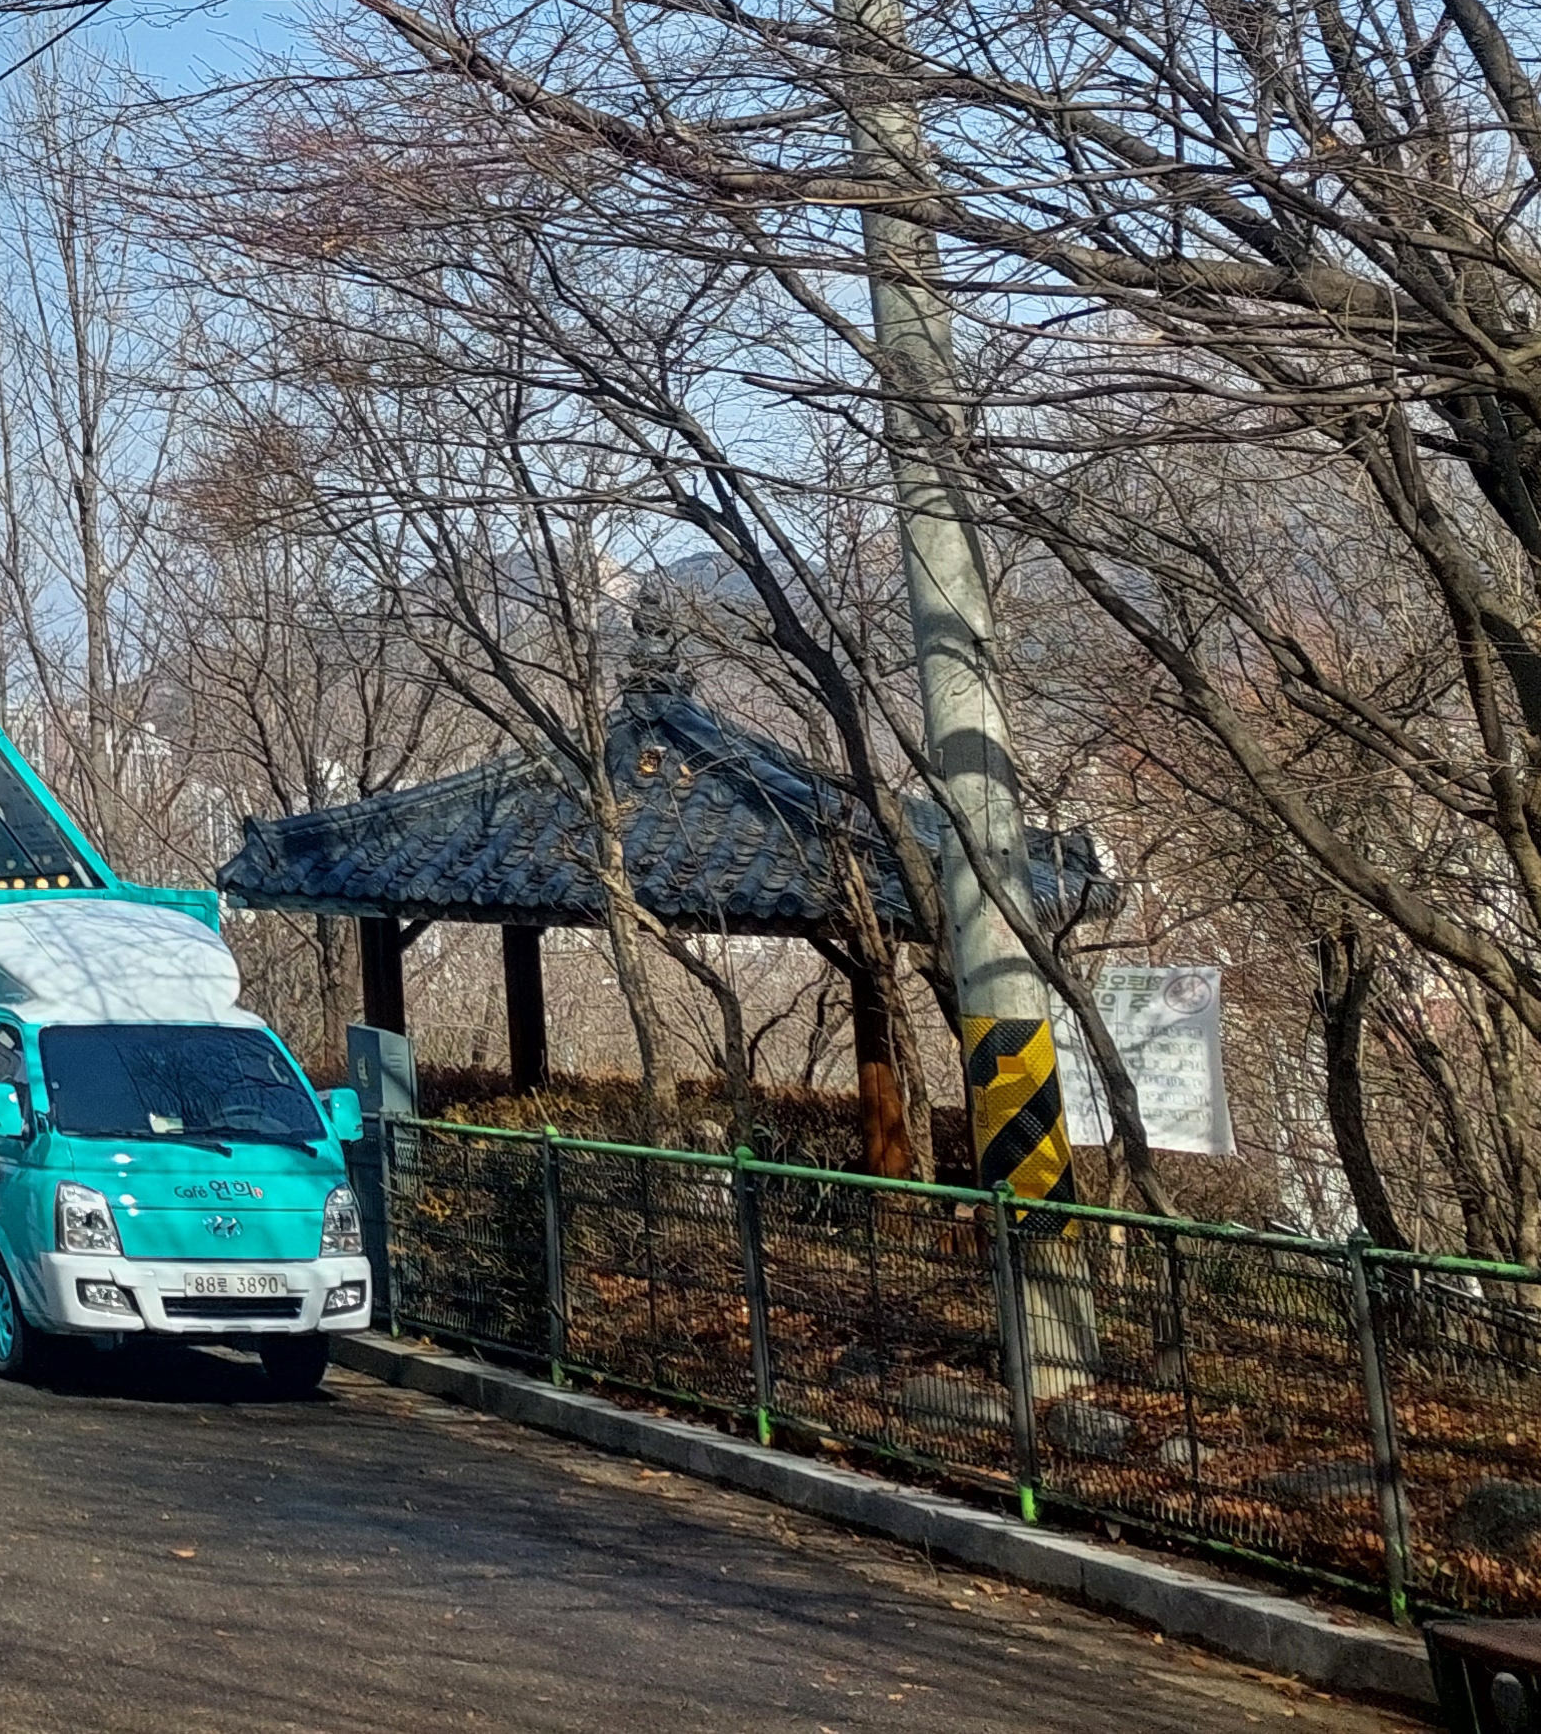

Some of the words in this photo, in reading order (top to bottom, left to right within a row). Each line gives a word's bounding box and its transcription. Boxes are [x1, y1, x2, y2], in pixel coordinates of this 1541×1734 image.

[209, 1180, 255, 1201] 연희
[194, 1276, 229, 1293] 88로
[236, 1276, 279, 1294] 3890
